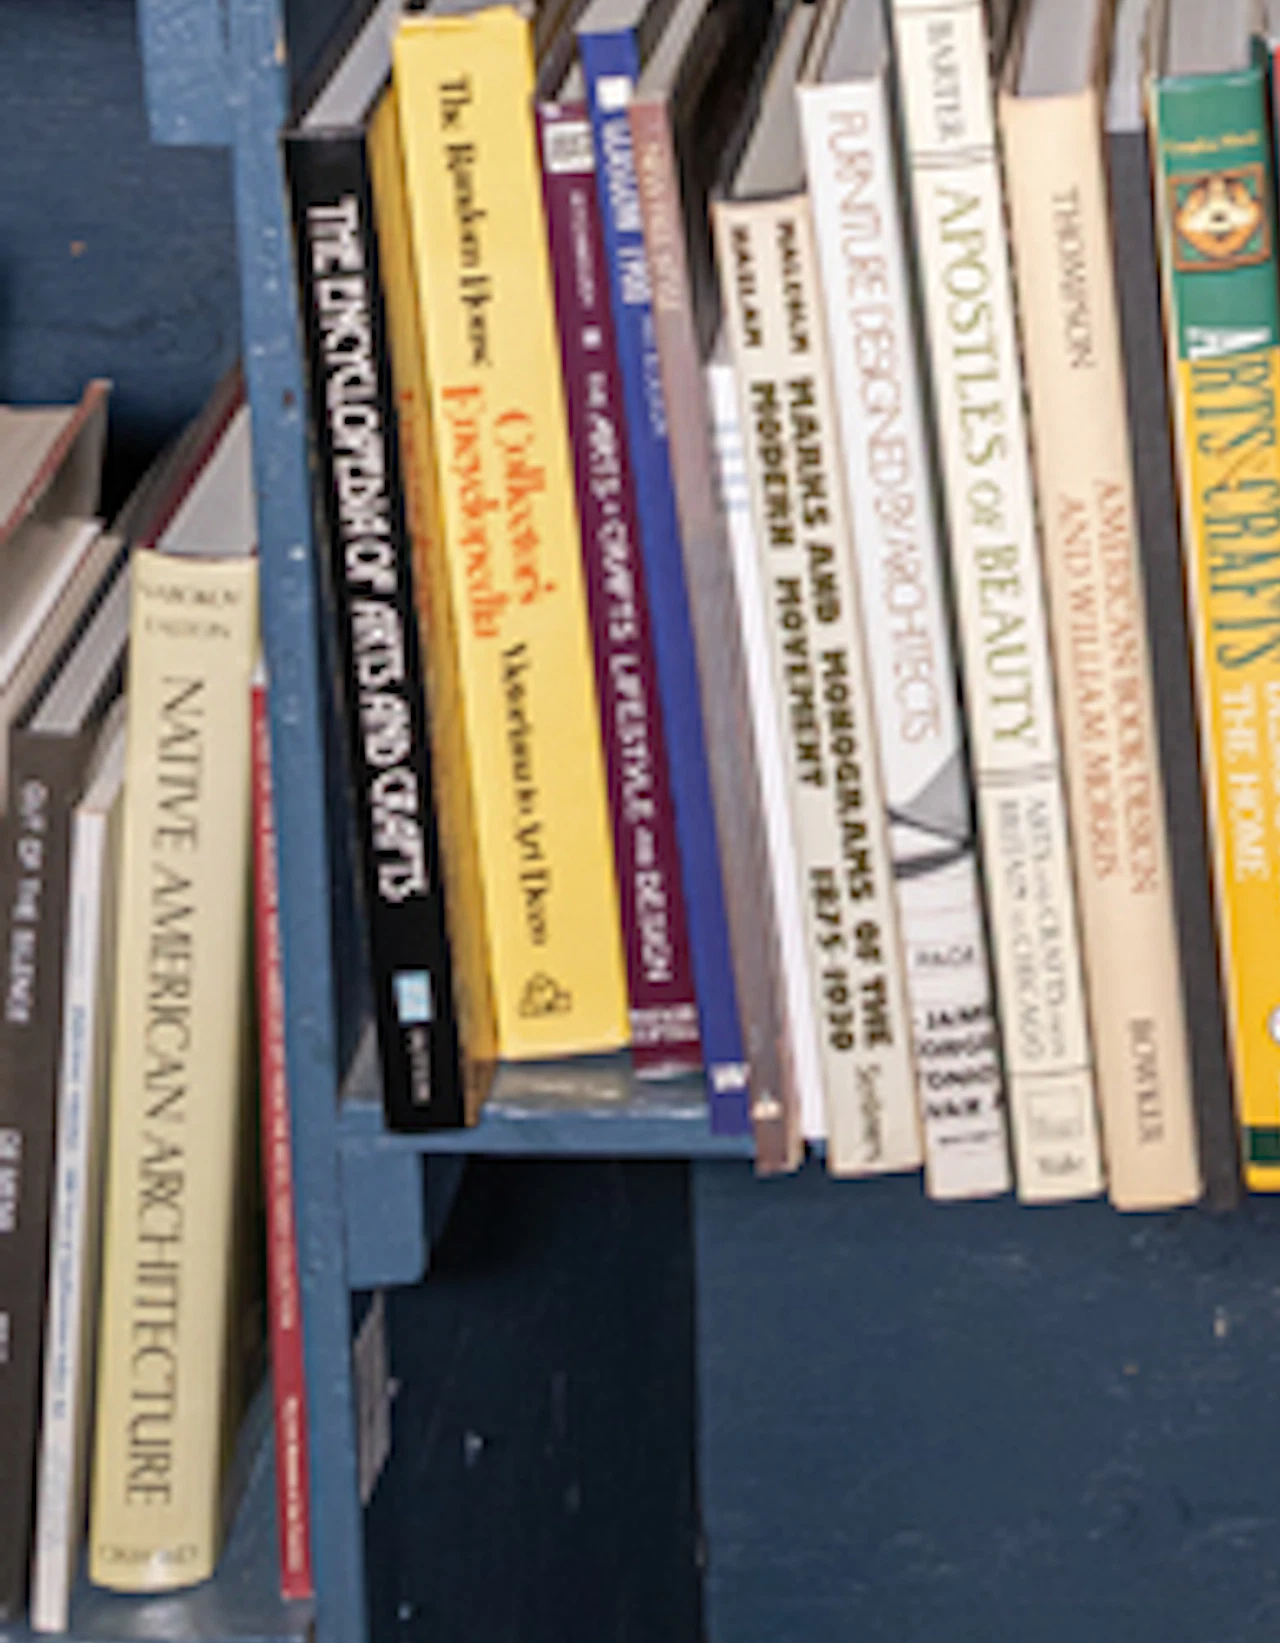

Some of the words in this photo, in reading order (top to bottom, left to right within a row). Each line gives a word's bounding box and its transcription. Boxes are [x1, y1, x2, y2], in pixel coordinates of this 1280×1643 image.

[438, 78, 472, 125] The
[308, 195, 362, 269] THE
[442, 143, 487, 269] Random
[456, 275, 493, 366] House
[934, 185, 1005, 464] APOSTLES
[316, 279, 397, 536] ENCYCLOPEDIA
[789, 378, 835, 526] MARKS
[341, 542, 399, 587] OF
[440, 384, 504, 639] Encyclopedia
[497, 410, 558, 603] Collector's
[968, 480, 1003, 529] OF
[347, 601, 407, 683] ARTS
[804, 544, 841, 624] AND
[975, 546, 1037, 748] BEAUTY
[152, 675, 206, 851] NATIVE
[358, 694, 416, 765] AND
[824, 650, 876, 901] MONOGRAMS
[1220, 683, 1256, 762] THE
[364, 771, 428, 899] CRAFTS
[1230, 771, 1270, 881] HOME
[140, 872, 198, 1120] AMERICAN
[854, 920, 887, 968] OF
[863, 977, 893, 1047] THE
[1128, 1017, 1165, 1146] BOWKER
[123, 1135, 194, 1508] ARCHITECTURE
